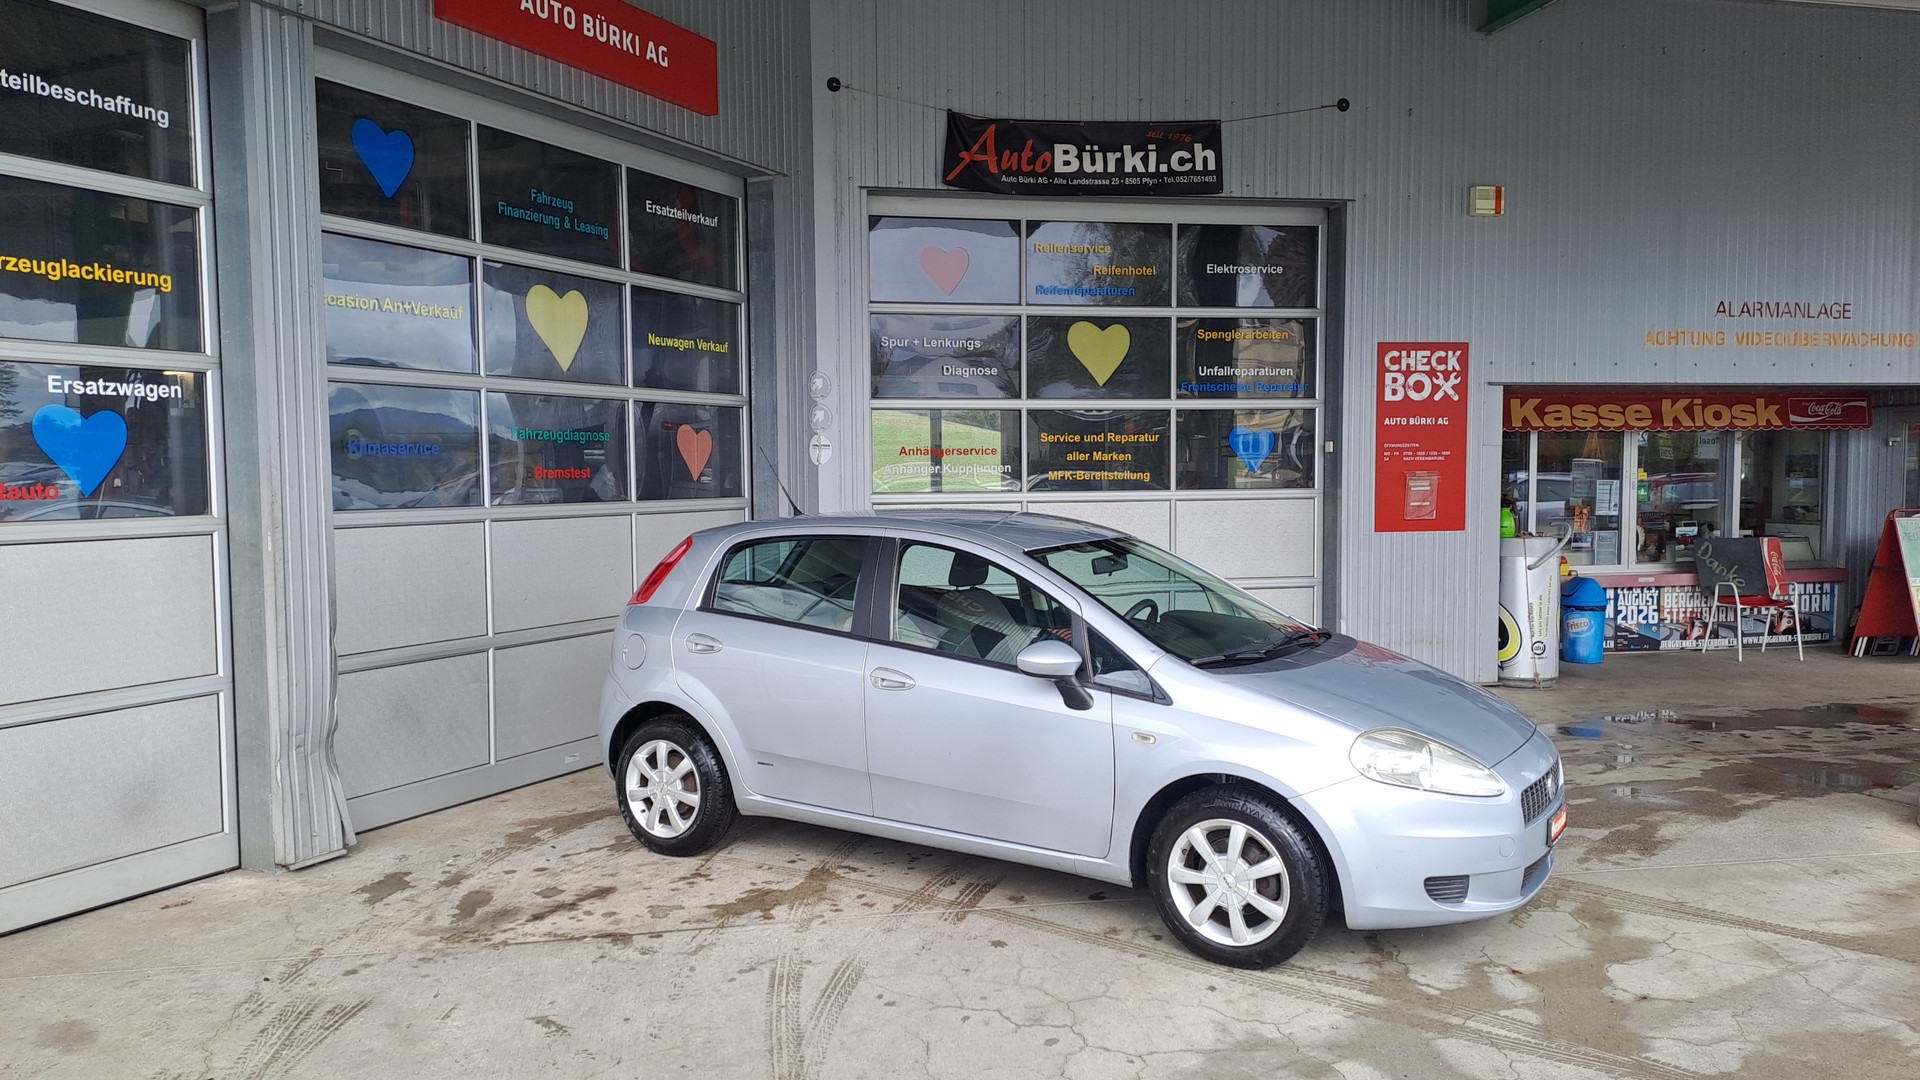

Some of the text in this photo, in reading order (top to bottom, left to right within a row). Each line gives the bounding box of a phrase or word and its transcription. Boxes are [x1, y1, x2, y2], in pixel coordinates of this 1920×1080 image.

[520, 0, 669, 68] AUTO BÜRKI AG
[0, 68, 170, 129] teilbeschaffung
[1167, 132, 1192, 143] 1976
[1001, 175, 1017, 183] Auto
[1018, 176, 1037, 184] Bürki
[1142, 178, 1158, 186] Pfyn
[530, 188, 574, 214] Fahrzeug
[498, 201, 609, 240] Finanzierung & Leasing
[645, 200, 719, 228] Ersatzteilverkauf
[1034, 242, 1111, 255] Reifenservice
[0, 255, 172, 292] rzeuglackierung
[1093, 264, 1156, 276] Reifenhotel
[1206, 263, 1284, 275] Elektroservice
[1035, 284, 1135, 298] Reifenreparaturen
[1715, 300, 1852, 319] ALARMANLAGE
[648, 332, 729, 354] Neuwagen Verkauf
[1196, 328, 1289, 343] Spenglerarbeiten
[1644, 330, 1726, 347] ACHTUNG
[880, 336, 981, 351] Spur + Lenkungs
[1384, 350, 1462, 372] CHECK
[942, 364, 998, 378] Diagnose
[1198, 365, 1294, 378] Unfallreparaturen
[47, 375, 182, 402] Ersatzwagen
[1181, 381, 1309, 394] Frontscheibe Reparatur
[1510, 398, 1783, 428] Kasse Kiosk
[1384, 416, 1449, 426] AUTO BÜRKI AG
[511, 426, 611, 444] Fahrzeugdiagnose
[1040, 431, 1160, 445] Service und Reparatur
[344, 438, 440, 456] Klimaservice
[898, 445, 997, 459] Anhängerservice
[1066, 450, 1132, 462] aller Marken
[533, 464, 592, 479] Bremstest
[942, 462, 1012, 477] Kupplungen
[1048, 468, 1151, 482] MFK-Bereitstellung
[1697, 541, 1746, 588] Danke
[1617, 593, 1659, 607] AUGUST
[1617, 605, 1659, 625] 2026
[1565, 619, 1589, 631] Frisco
